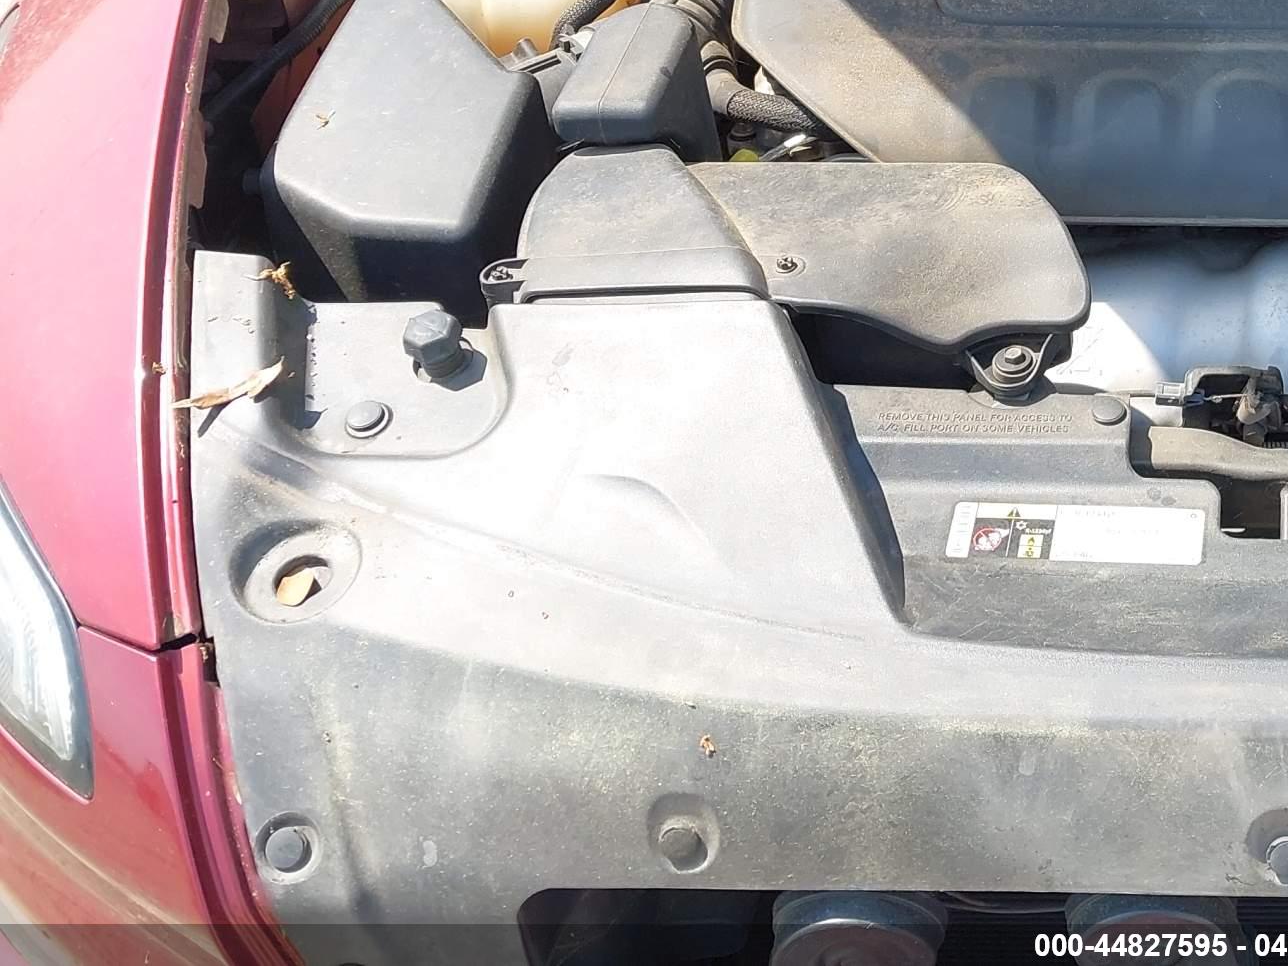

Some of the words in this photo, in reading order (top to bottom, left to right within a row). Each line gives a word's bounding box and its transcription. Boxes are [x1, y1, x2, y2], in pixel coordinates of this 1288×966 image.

[878, 412, 923, 421] REMOVE
[925, 412, 950, 421] THIS
[952, 412, 987, 422] PANEL
[989, 414, 1011, 422] FOR
[1013, 414, 1056, 423] ACCESS
[1059, 414, 1073, 423] TO
[877, 423, 899, 433] A/C
[904, 424, 926, 433] FILL
[930, 425, 959, 434] PORT
[962, 425, 979, 434] ON
[982, 425, 1013, 434] SOME
[1017, 425, 1070, 434] VEHICLES
